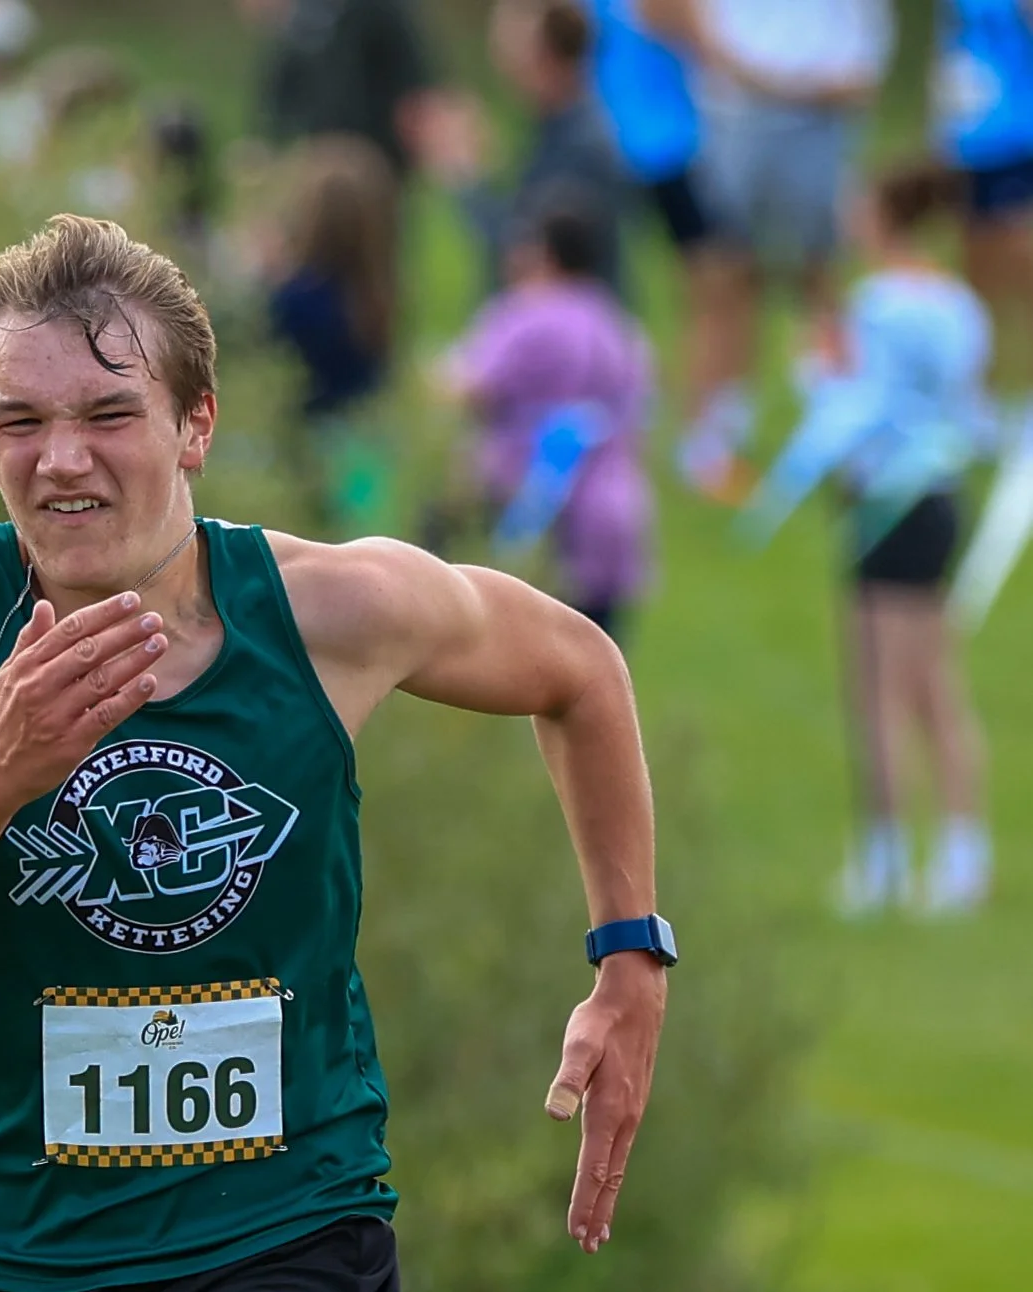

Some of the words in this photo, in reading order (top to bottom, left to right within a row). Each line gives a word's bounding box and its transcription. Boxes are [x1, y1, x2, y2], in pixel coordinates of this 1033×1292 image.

[64, 746, 224, 806] WATERFORD
[75, 786, 232, 906] XC
[86, 870, 253, 946] KETTERING
[69, 1057, 257, 1134] 1166
